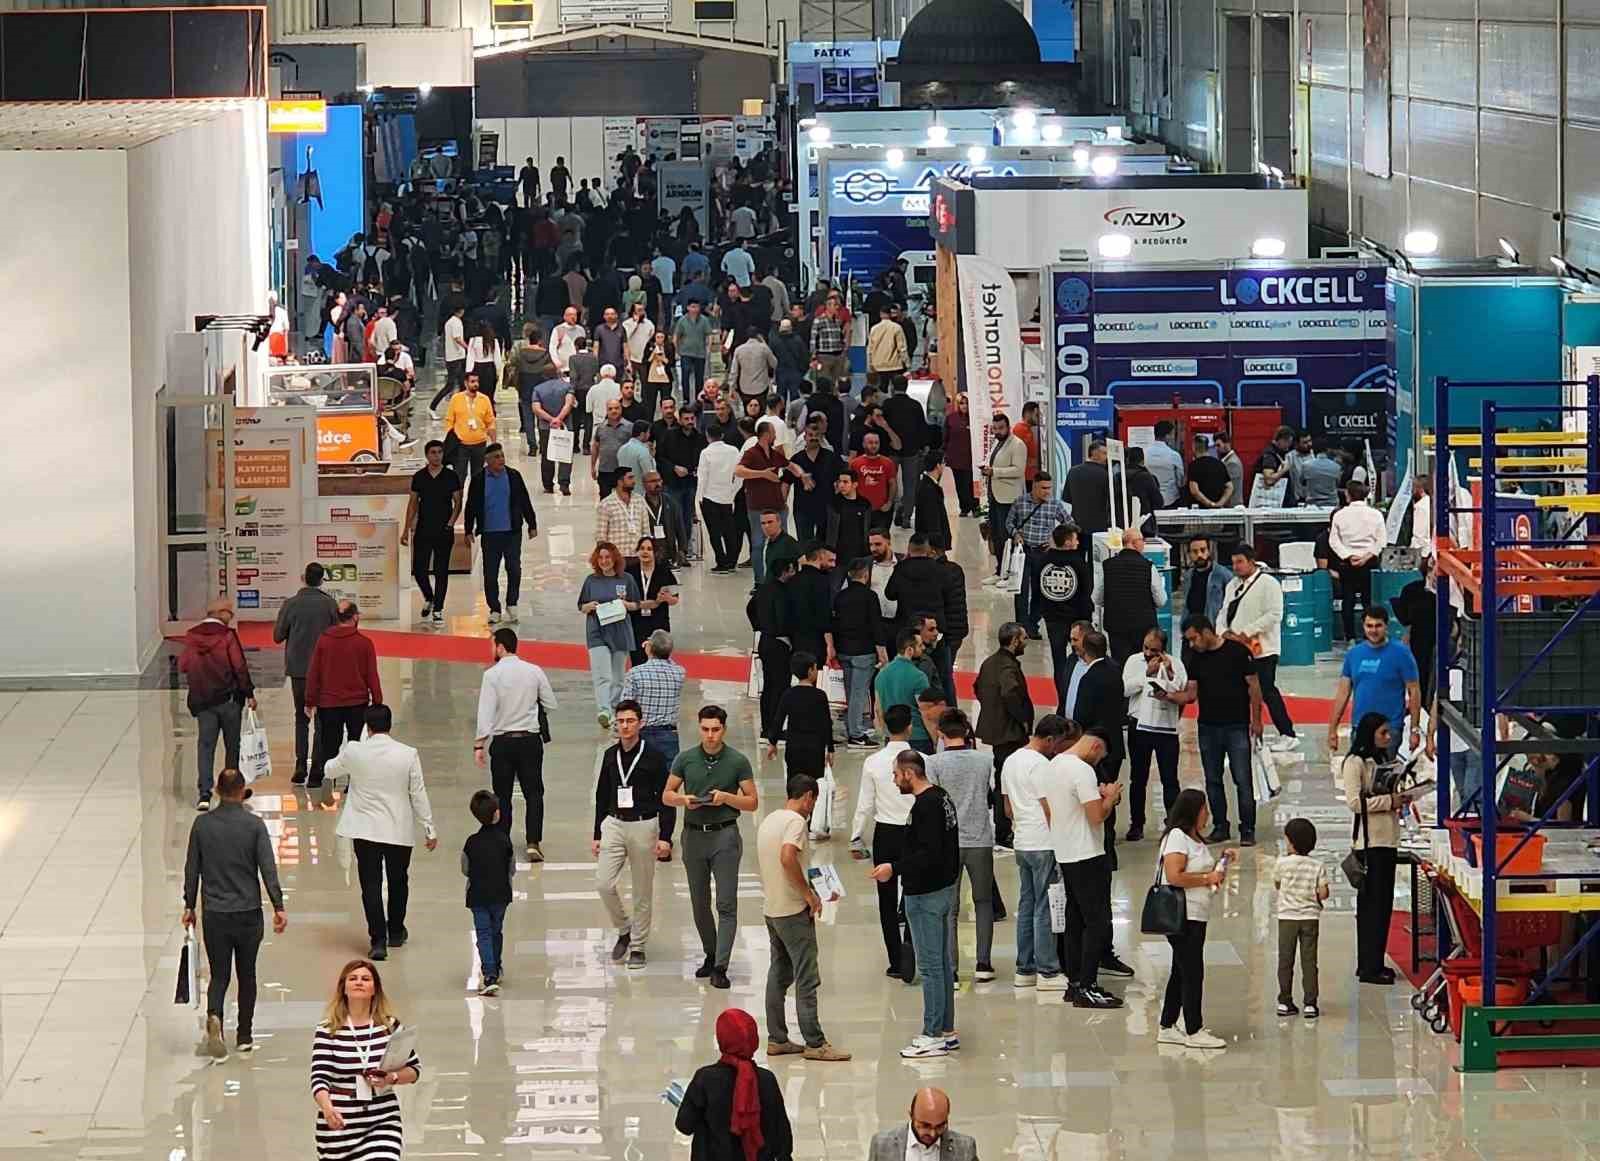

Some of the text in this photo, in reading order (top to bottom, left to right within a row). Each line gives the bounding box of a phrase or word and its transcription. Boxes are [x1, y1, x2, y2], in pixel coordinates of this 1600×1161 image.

[814, 48, 852, 58] FATEK
[1121, 212, 1169, 226] AZM
[1220, 276, 1363, 305] LOCKCELL
